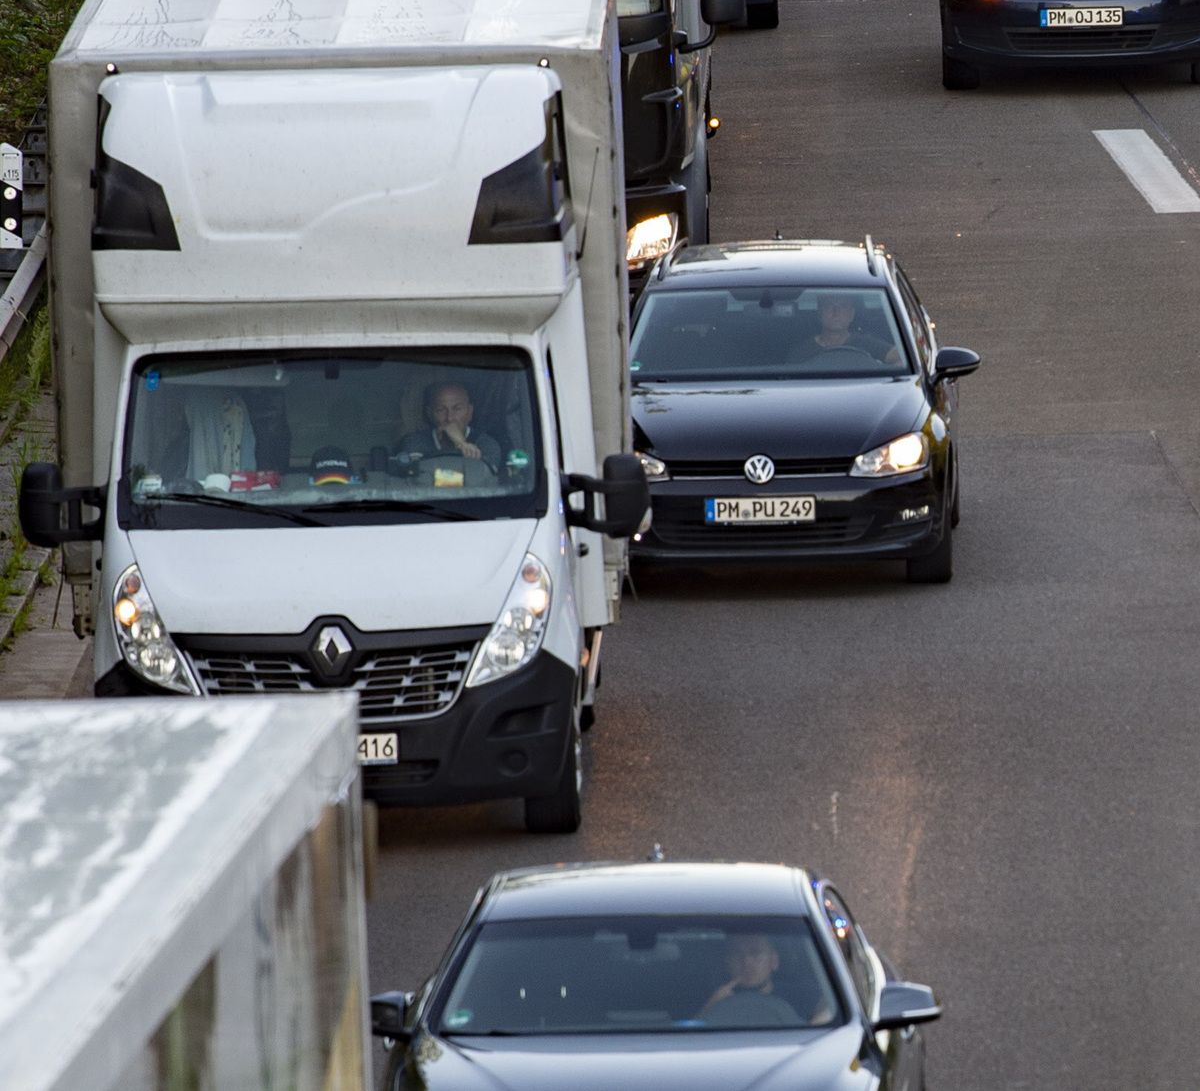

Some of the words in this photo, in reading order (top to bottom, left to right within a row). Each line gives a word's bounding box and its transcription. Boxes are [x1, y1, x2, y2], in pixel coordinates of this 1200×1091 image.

[1049, 11, 1066, 24] PM
[1075, 11, 1093, 24] OJ
[1096, 10, 1121, 23] 135
[716, 501, 739, 518] PM
[752, 501, 775, 518] PU
[780, 500, 812, 517] 249
[358, 737, 394, 758] 416
